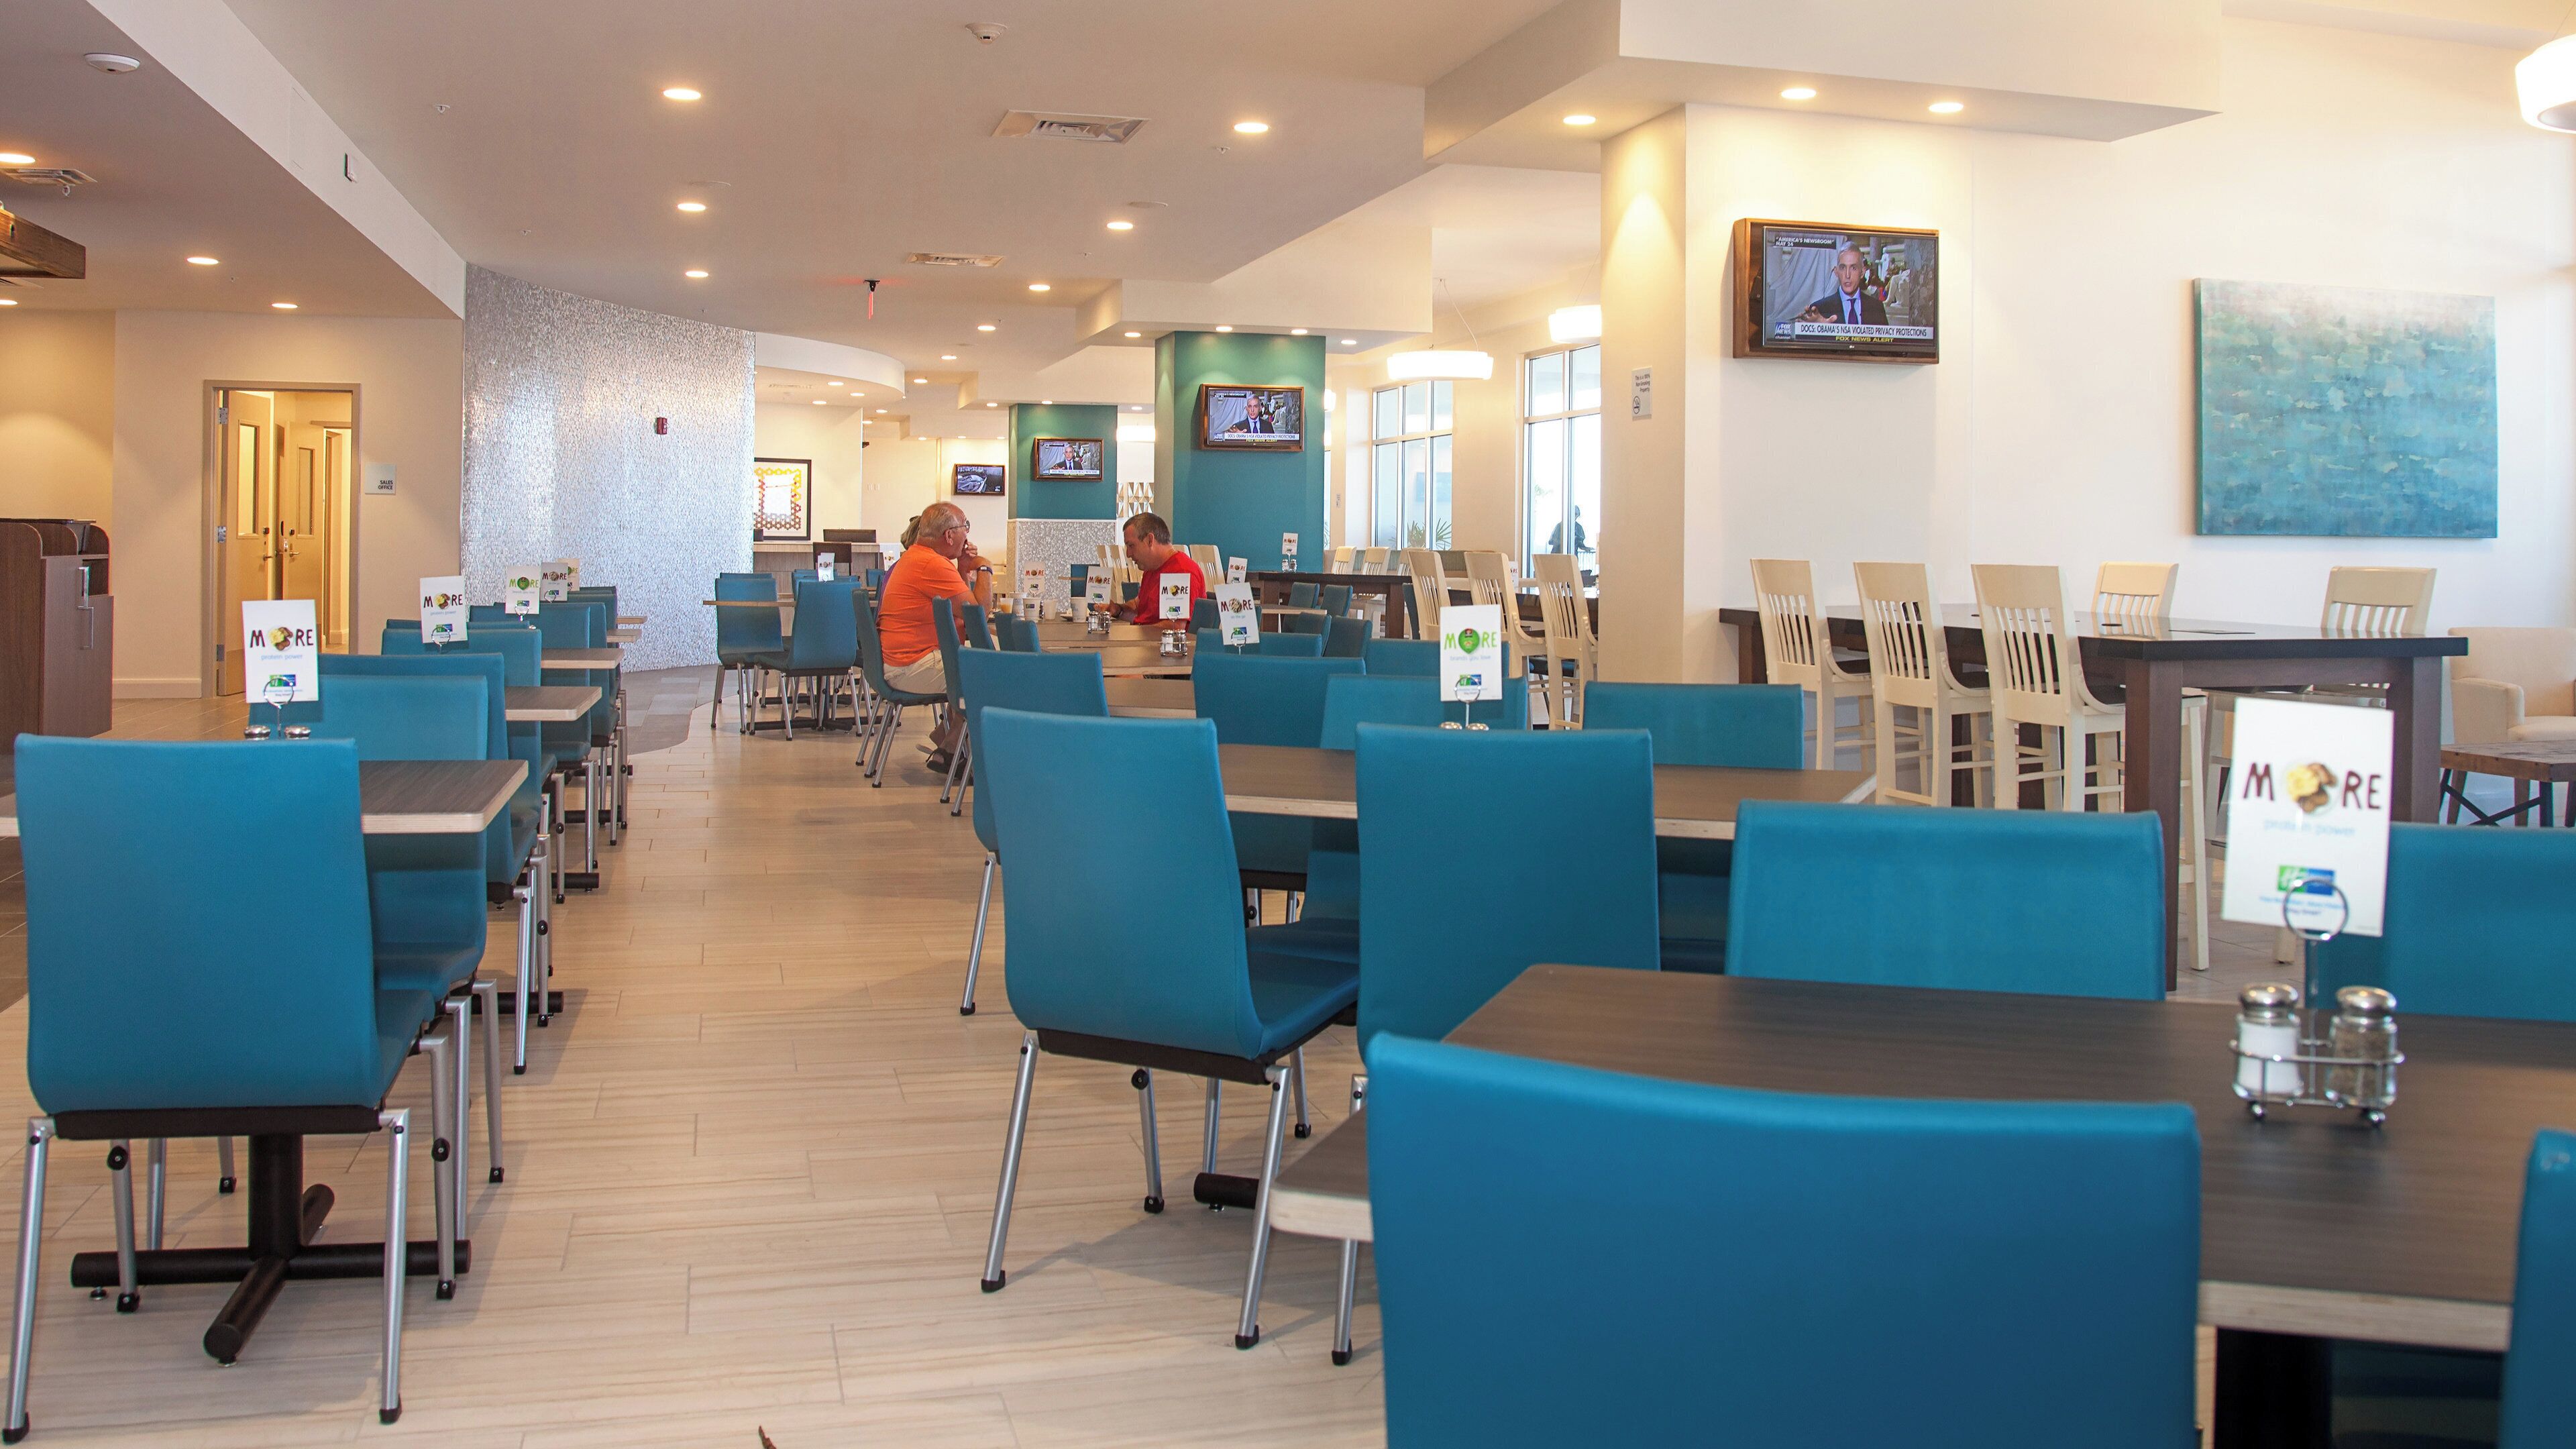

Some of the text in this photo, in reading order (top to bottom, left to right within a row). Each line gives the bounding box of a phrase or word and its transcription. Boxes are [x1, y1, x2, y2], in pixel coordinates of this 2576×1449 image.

[1801, 325, 1927, 337] DOCS: OBAMA'S NSA VIOLATED PRIVACY PROTECTIONS
